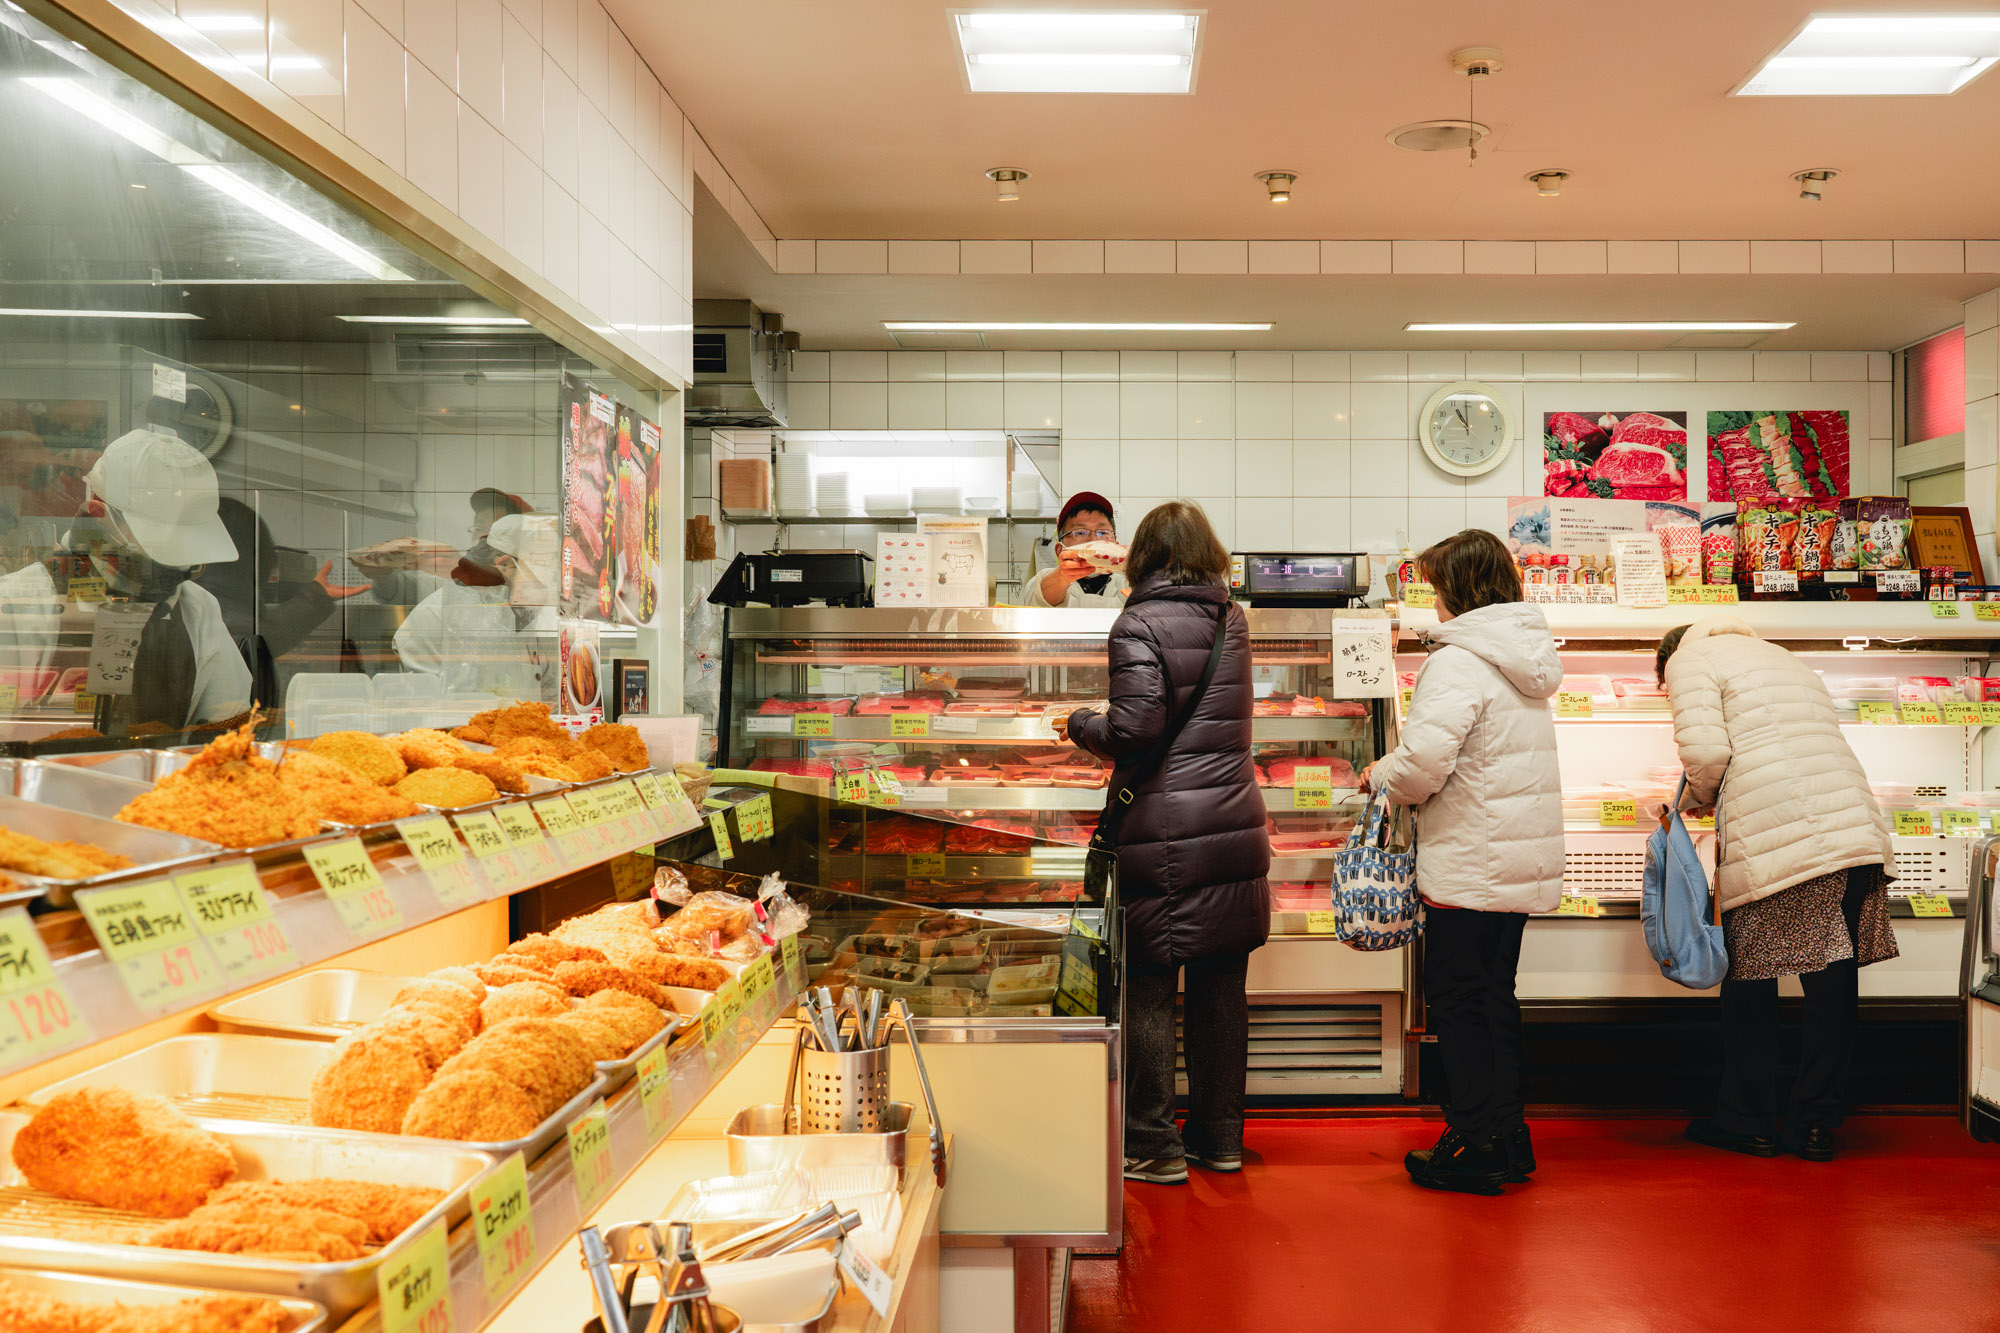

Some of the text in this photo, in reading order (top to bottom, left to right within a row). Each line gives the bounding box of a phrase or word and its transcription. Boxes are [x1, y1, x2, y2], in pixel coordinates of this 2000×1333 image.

[600, 473, 614, 612] ステーキ
[1764, 514, 1779, 563] キムチ鍋
[1803, 514, 1820, 563] キムチ鍋
[1834, 525, 1846, 553] もつ鍋
[1881, 525, 1894, 551] もつ鍋
[1766, 583, 1795, 592] 248 268
[1888, 583, 1917, 592] 248 268
[1682, 594, 1700, 603] 340
[1716, 594, 1735, 603] 240
[1346, 670, 1368, 678] ロースト
[1920, 714, 1938, 723] 165
[1962, 715, 1980, 723] 150
[815, 727, 829, 735] 750
[1296, 770, 1330, 783] おすすめ品
[843, 779, 861, 790] 上白糖
[850, 787, 866, 800] 230
[1315, 799, 1328, 807] 700
[1914, 825, 1931, 835] 130
[420, 838, 455, 860] イカフライ
[197, 891, 259, 923] えびフライ
[361, 888, 395, 921] 125
[1576, 904, 1594, 914] 118
[106, 913, 186, 946] 白身魚フライ
[242, 922, 287, 960] 200
[162, 945, 200, 987] 67
[8, 988, 70, 1041] 120
[485, 1190, 522, 1237] ロースカツ
